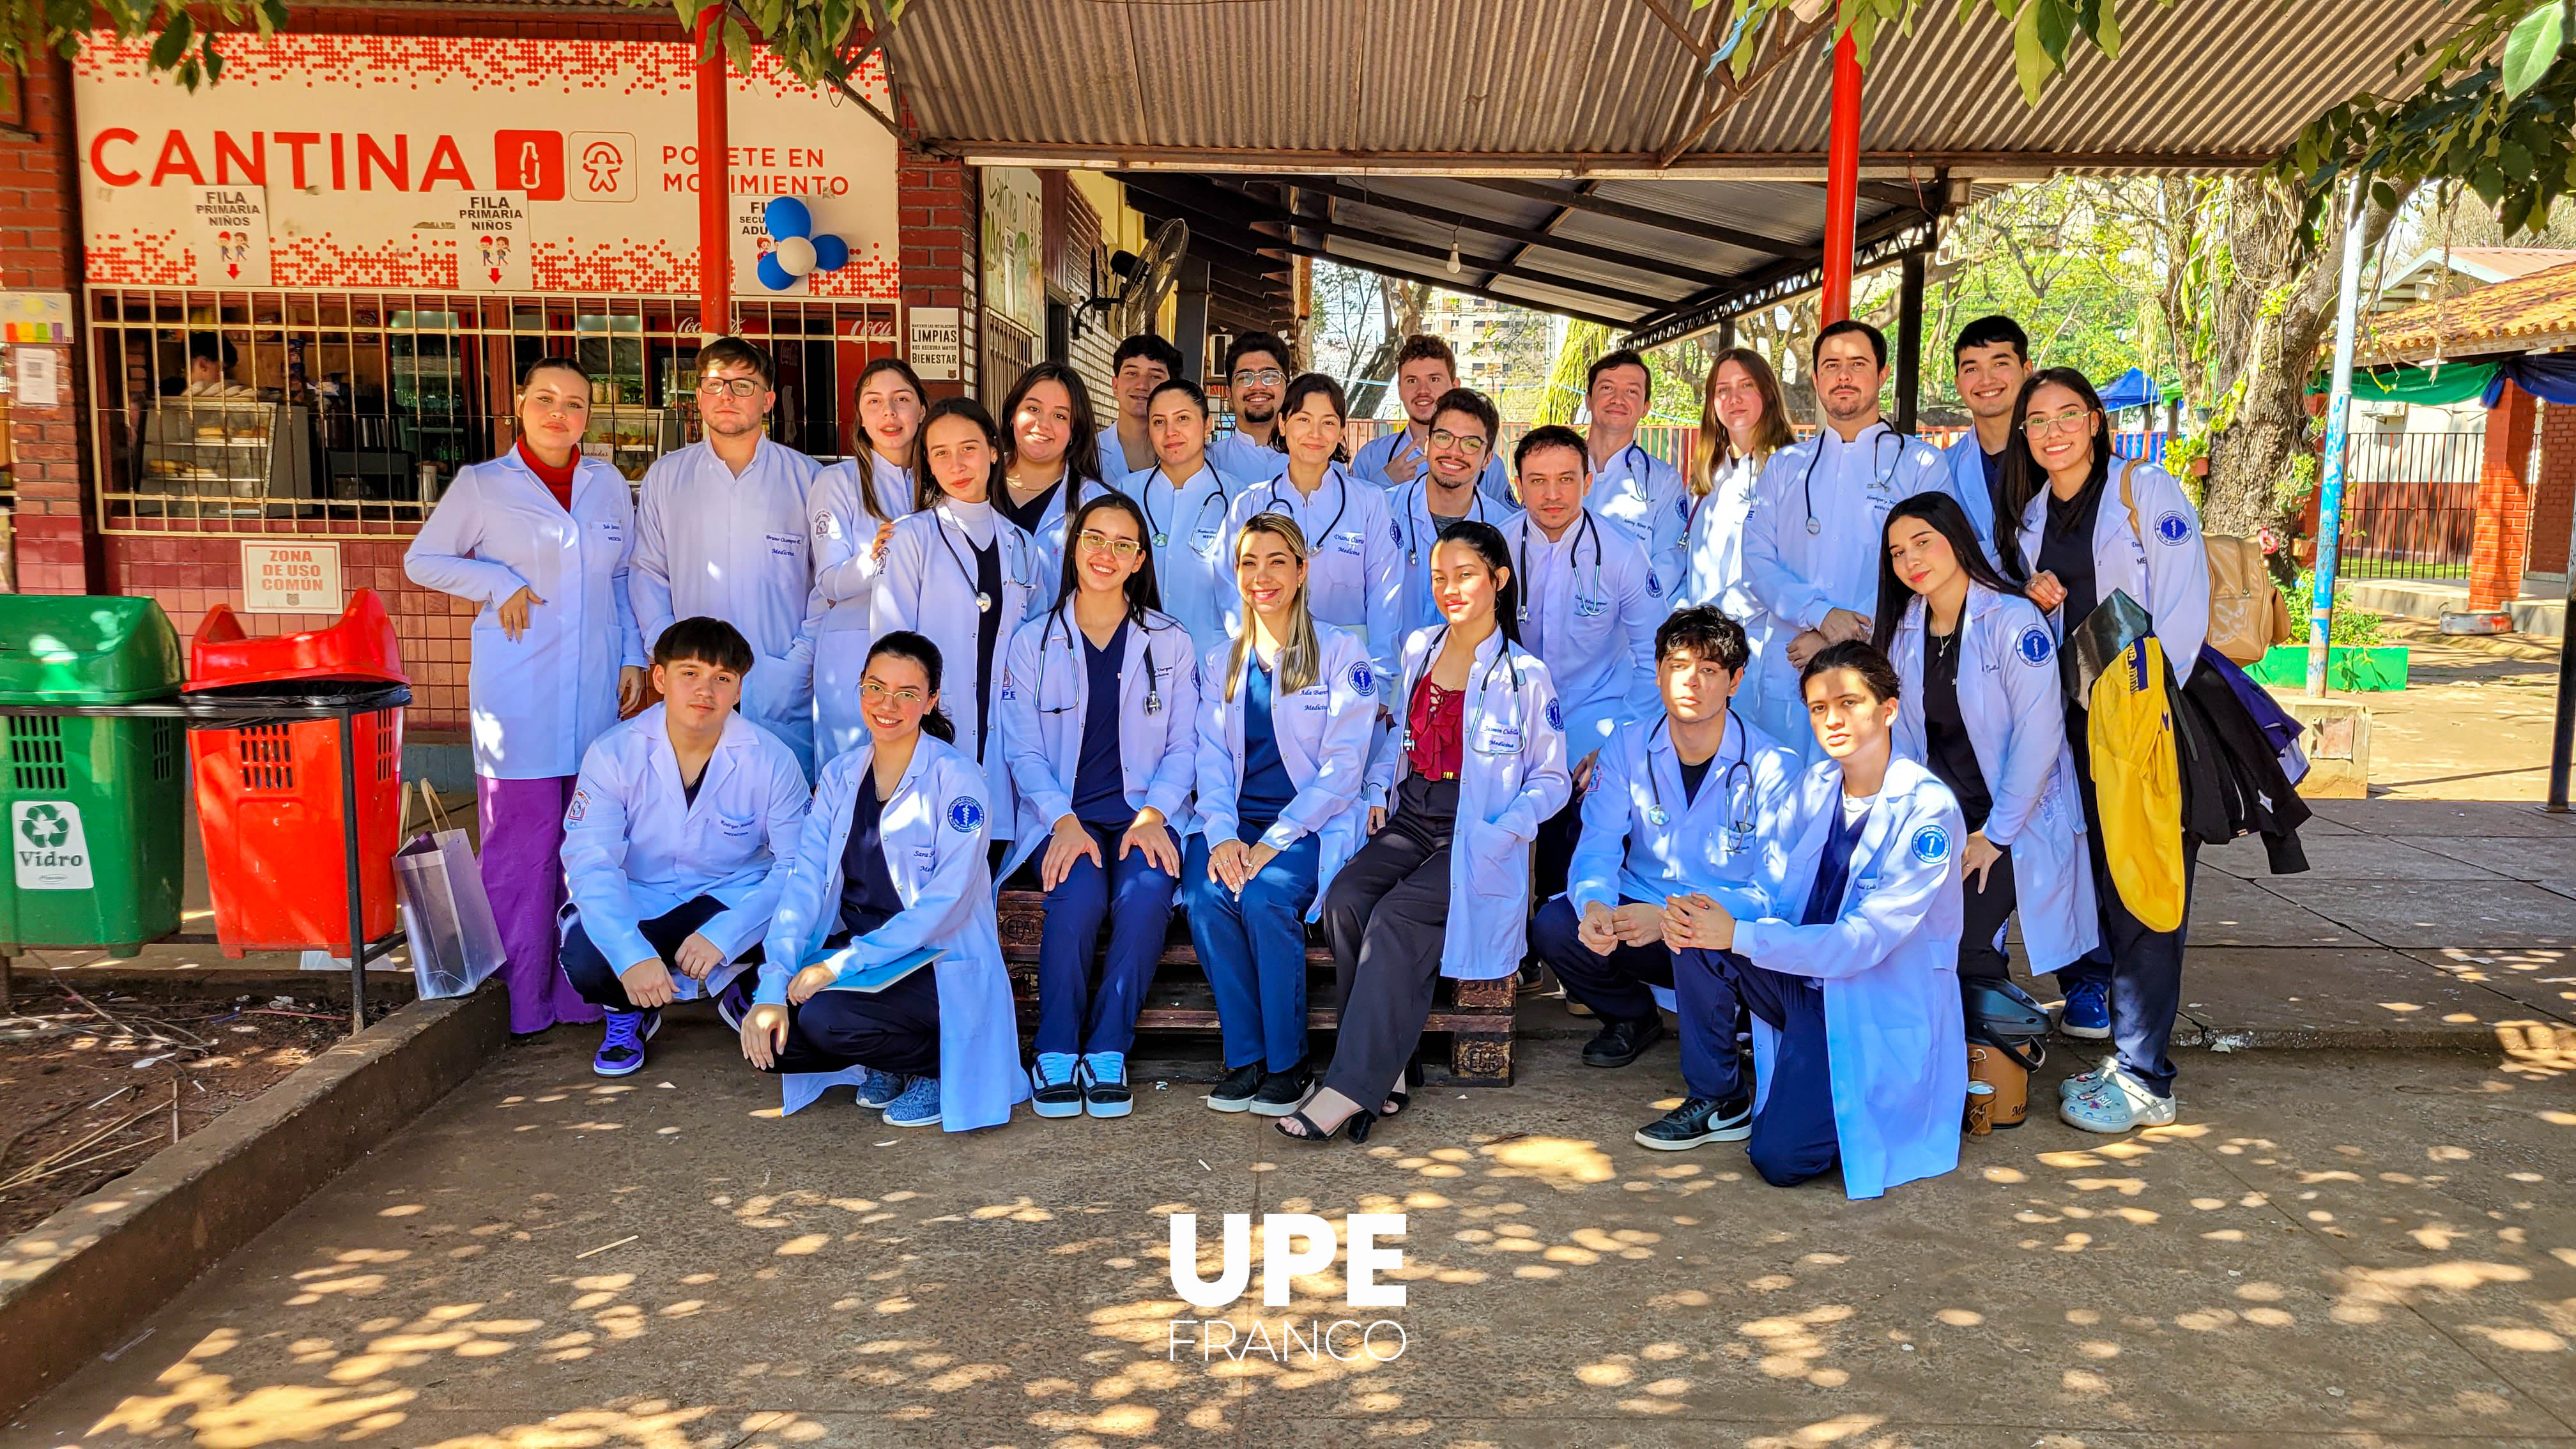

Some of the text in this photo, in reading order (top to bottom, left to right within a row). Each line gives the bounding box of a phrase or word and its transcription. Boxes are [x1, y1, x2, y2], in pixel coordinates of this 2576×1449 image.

[89, 127, 476, 192] CANTINA
[663, 146, 824, 168] POETE EN
[664, 173, 849, 195] MOIMIENTO
[206, 191, 247, 204] FILA
[470, 196, 510, 209] FILA
[195, 205, 261, 214] PRIMARIA
[459, 210, 523, 218] PRIMARIA
[751, 202, 771, 214] FI
[208, 215, 251, 226] NIÑOS
[471, 219, 513, 231] NIÑOS
[742, 226, 769, 235] ADU
[912, 328, 957, 343] LIMPIAS
[912, 353, 957, 365] BIENESTAR
[269, 549, 313, 563] ZONA
[262, 564, 321, 577] DE USO
[261, 577, 324, 592] COMÚN
[19, 850, 84, 867] Vidro
